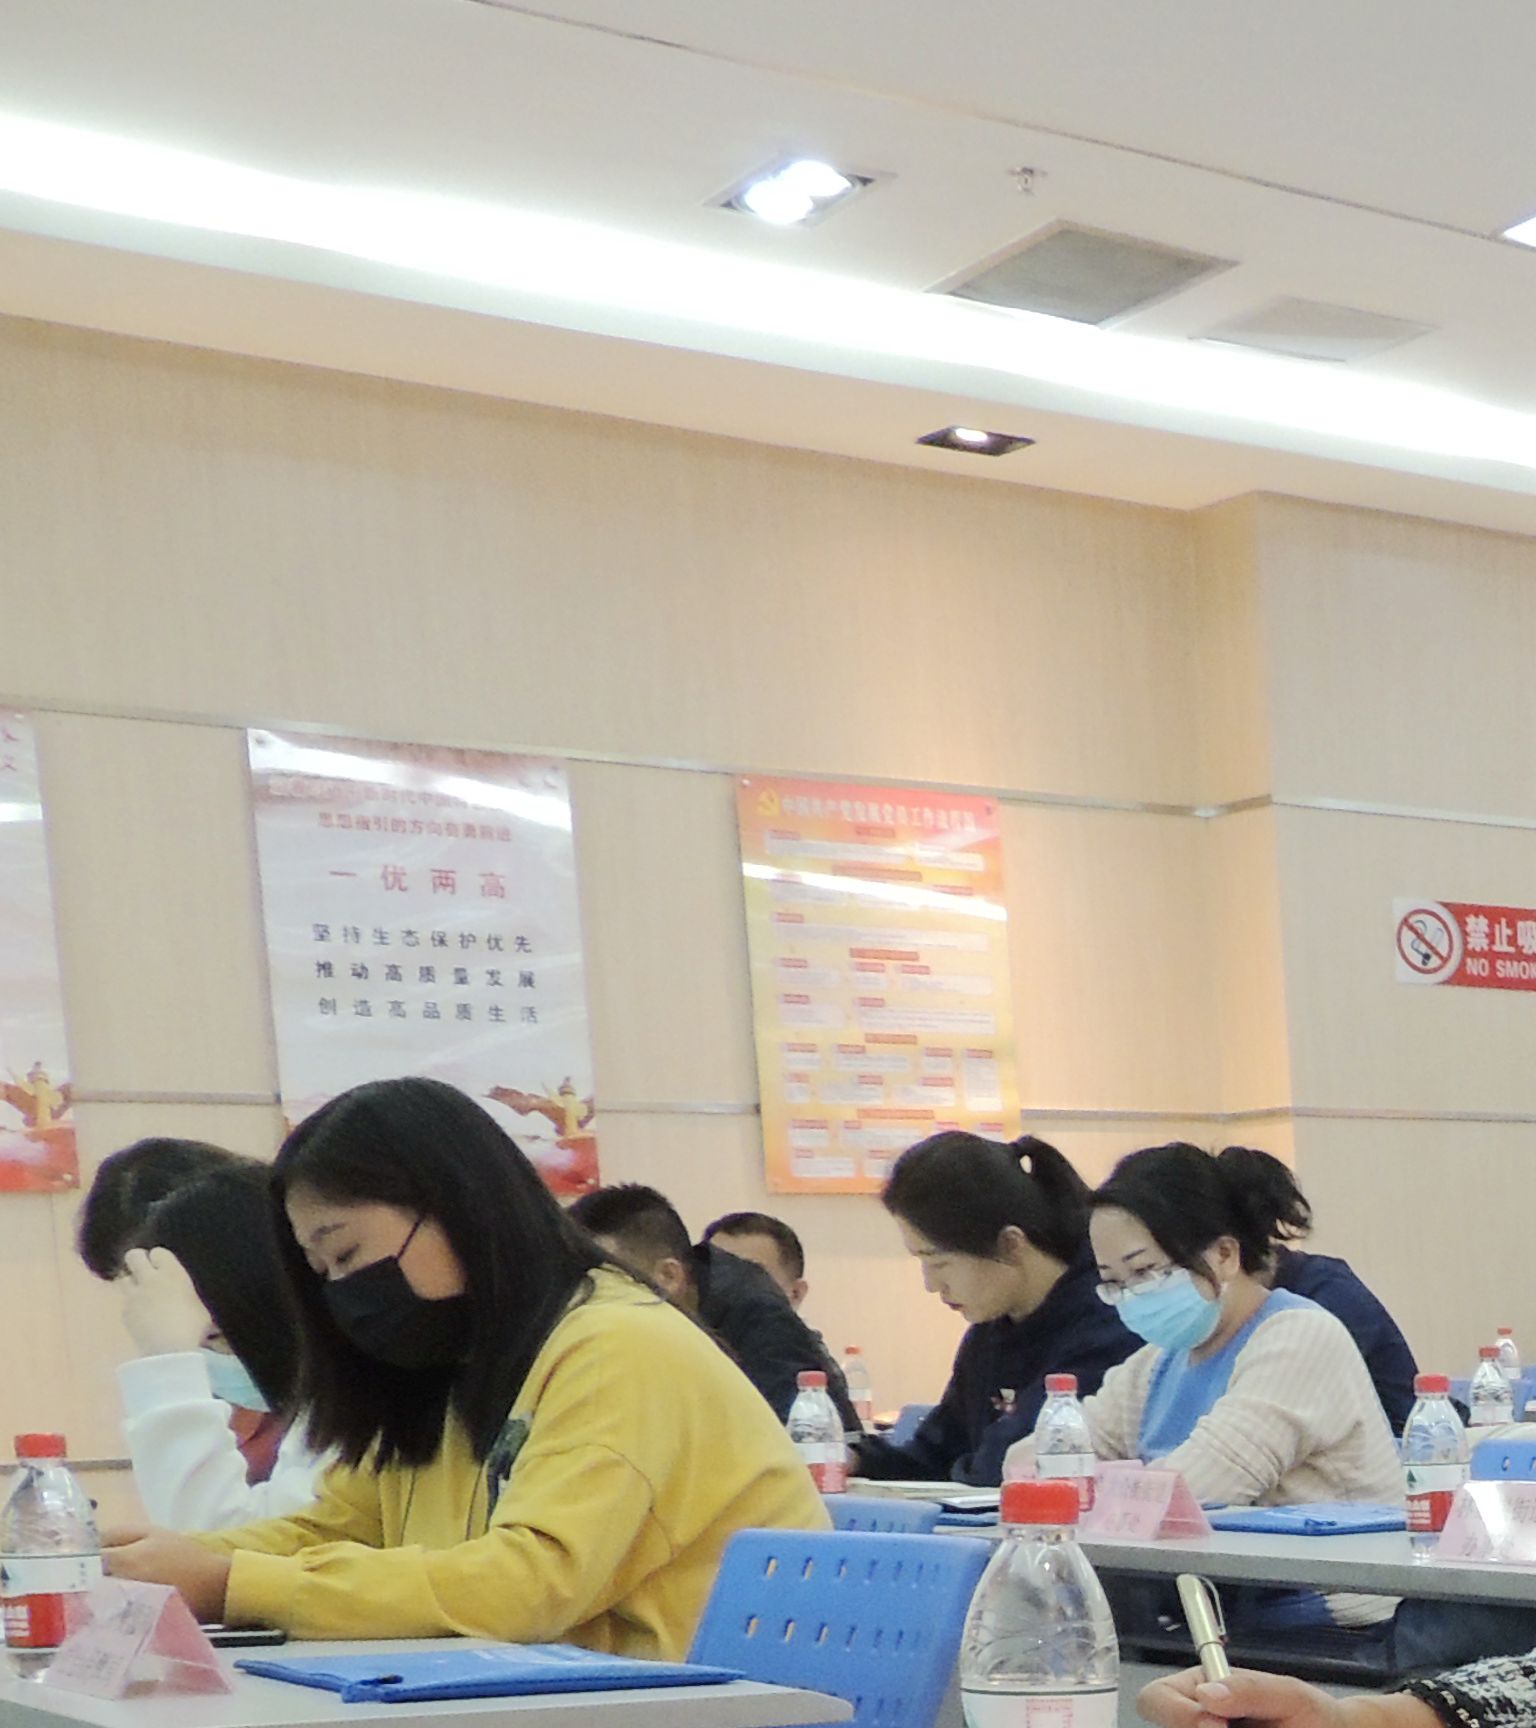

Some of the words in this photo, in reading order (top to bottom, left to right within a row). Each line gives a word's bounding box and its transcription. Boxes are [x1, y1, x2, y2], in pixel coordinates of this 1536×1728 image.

[329, 863, 507, 898] 一优两高
[312, 923, 533, 954] 坚持生态保护优先
[315, 961, 536, 989] 推动高质量发展
[1465, 957, 1490, 977] NO
[318, 997, 539, 1024] 创造高品质生活
